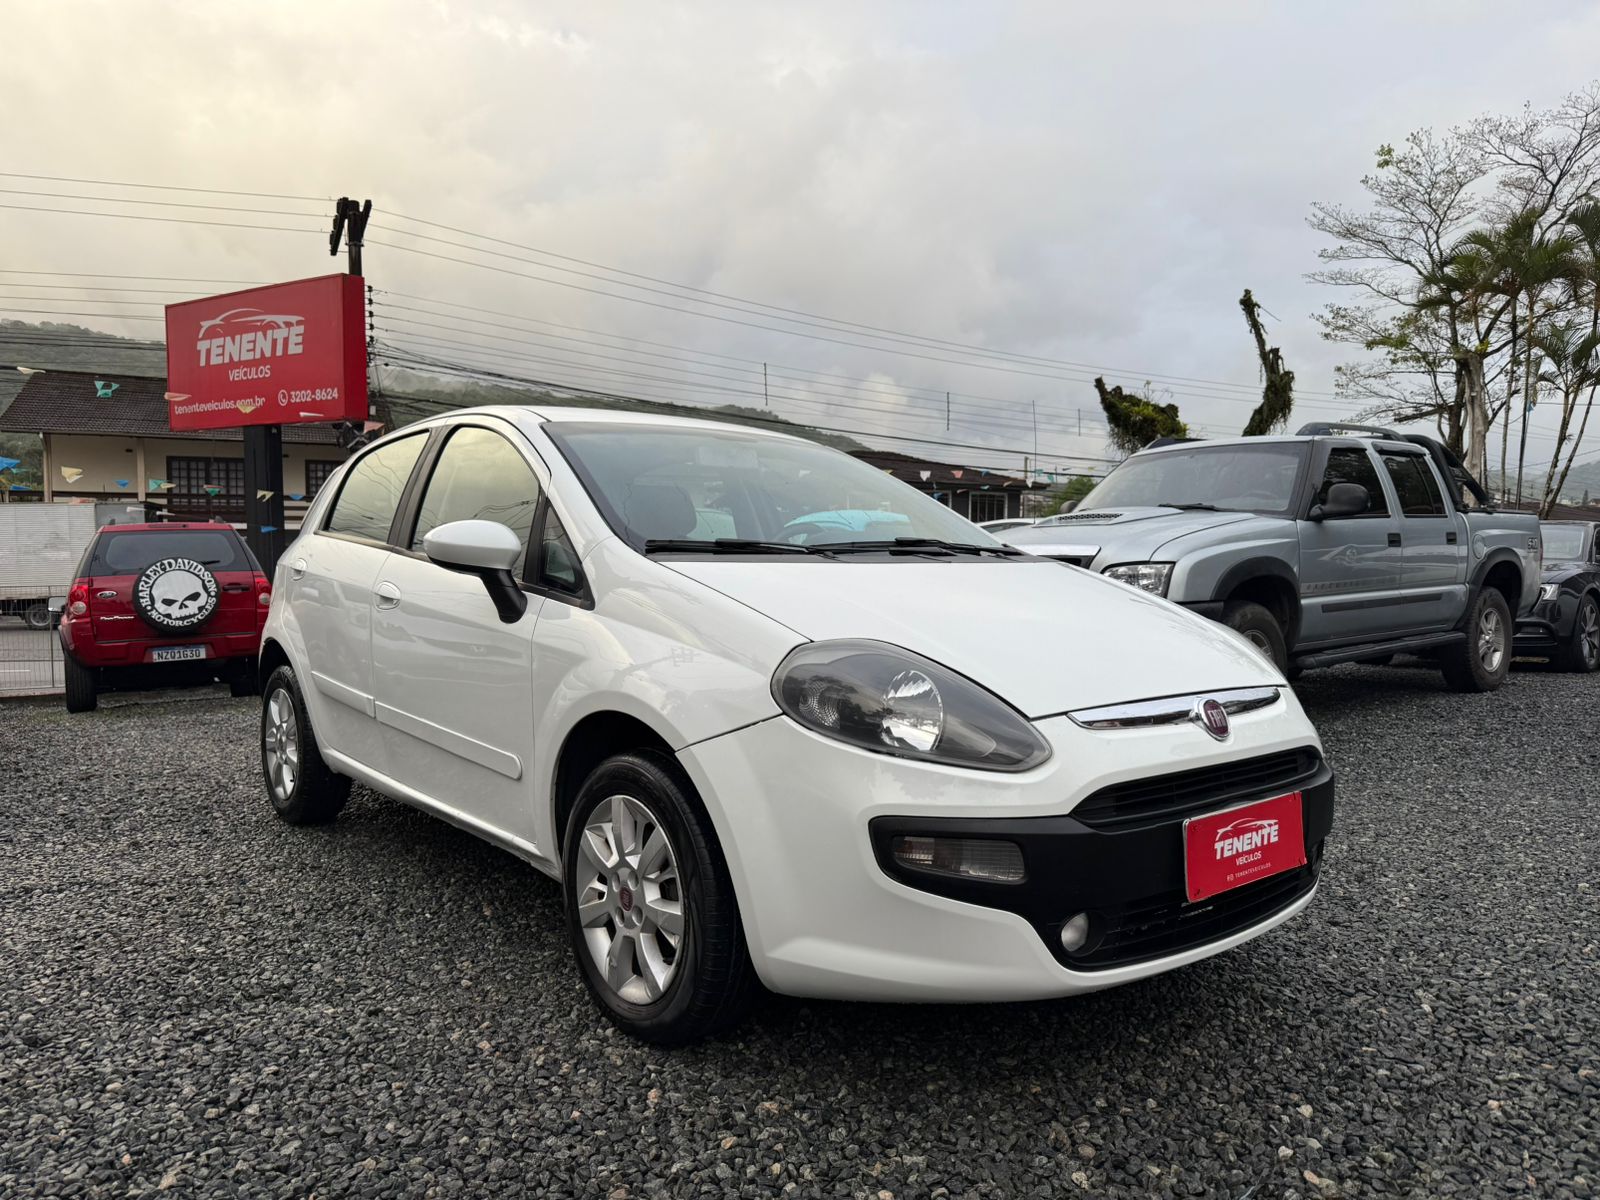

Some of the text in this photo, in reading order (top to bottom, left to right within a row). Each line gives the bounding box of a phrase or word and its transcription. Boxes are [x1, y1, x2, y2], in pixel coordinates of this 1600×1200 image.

[197, 325, 304, 367] TENENTE
[229, 365, 271, 382] VEÍCULOS
[290, 388, 338, 402] 3202-8624
[138, 558, 217, 607] HARLEY-DAVIDSON
[148, 596, 217, 627] MOTORCYCLES
[1207, 709, 1226, 728] FIAT
[1214, 824, 1279, 860] TENENTE
